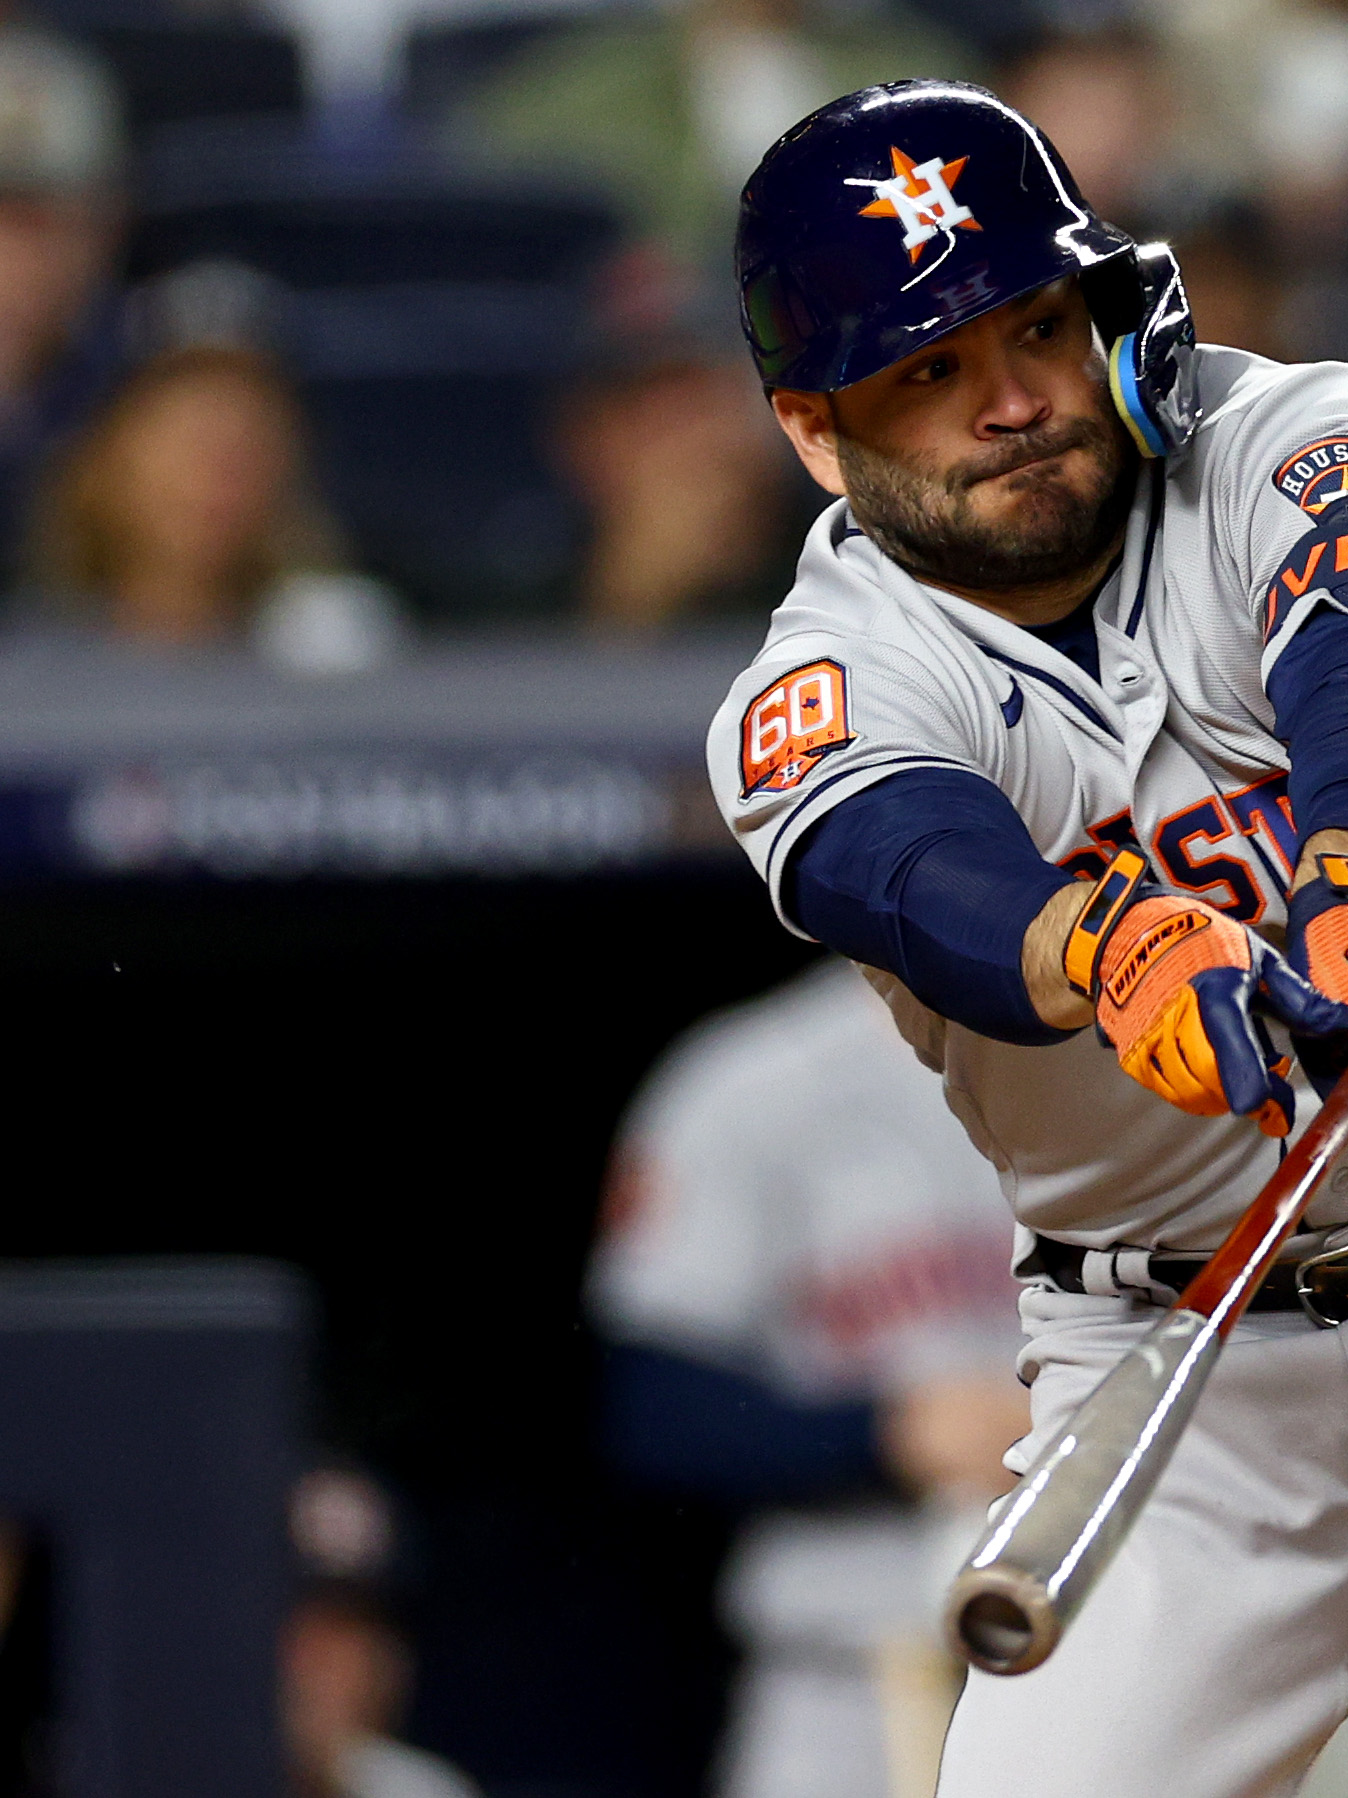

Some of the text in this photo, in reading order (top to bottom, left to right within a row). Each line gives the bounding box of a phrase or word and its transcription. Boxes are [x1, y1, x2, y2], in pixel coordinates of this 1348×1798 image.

[875, 157, 974, 250] H
[751, 671, 834, 763] 60
[752, 731, 836, 779] YEARS
